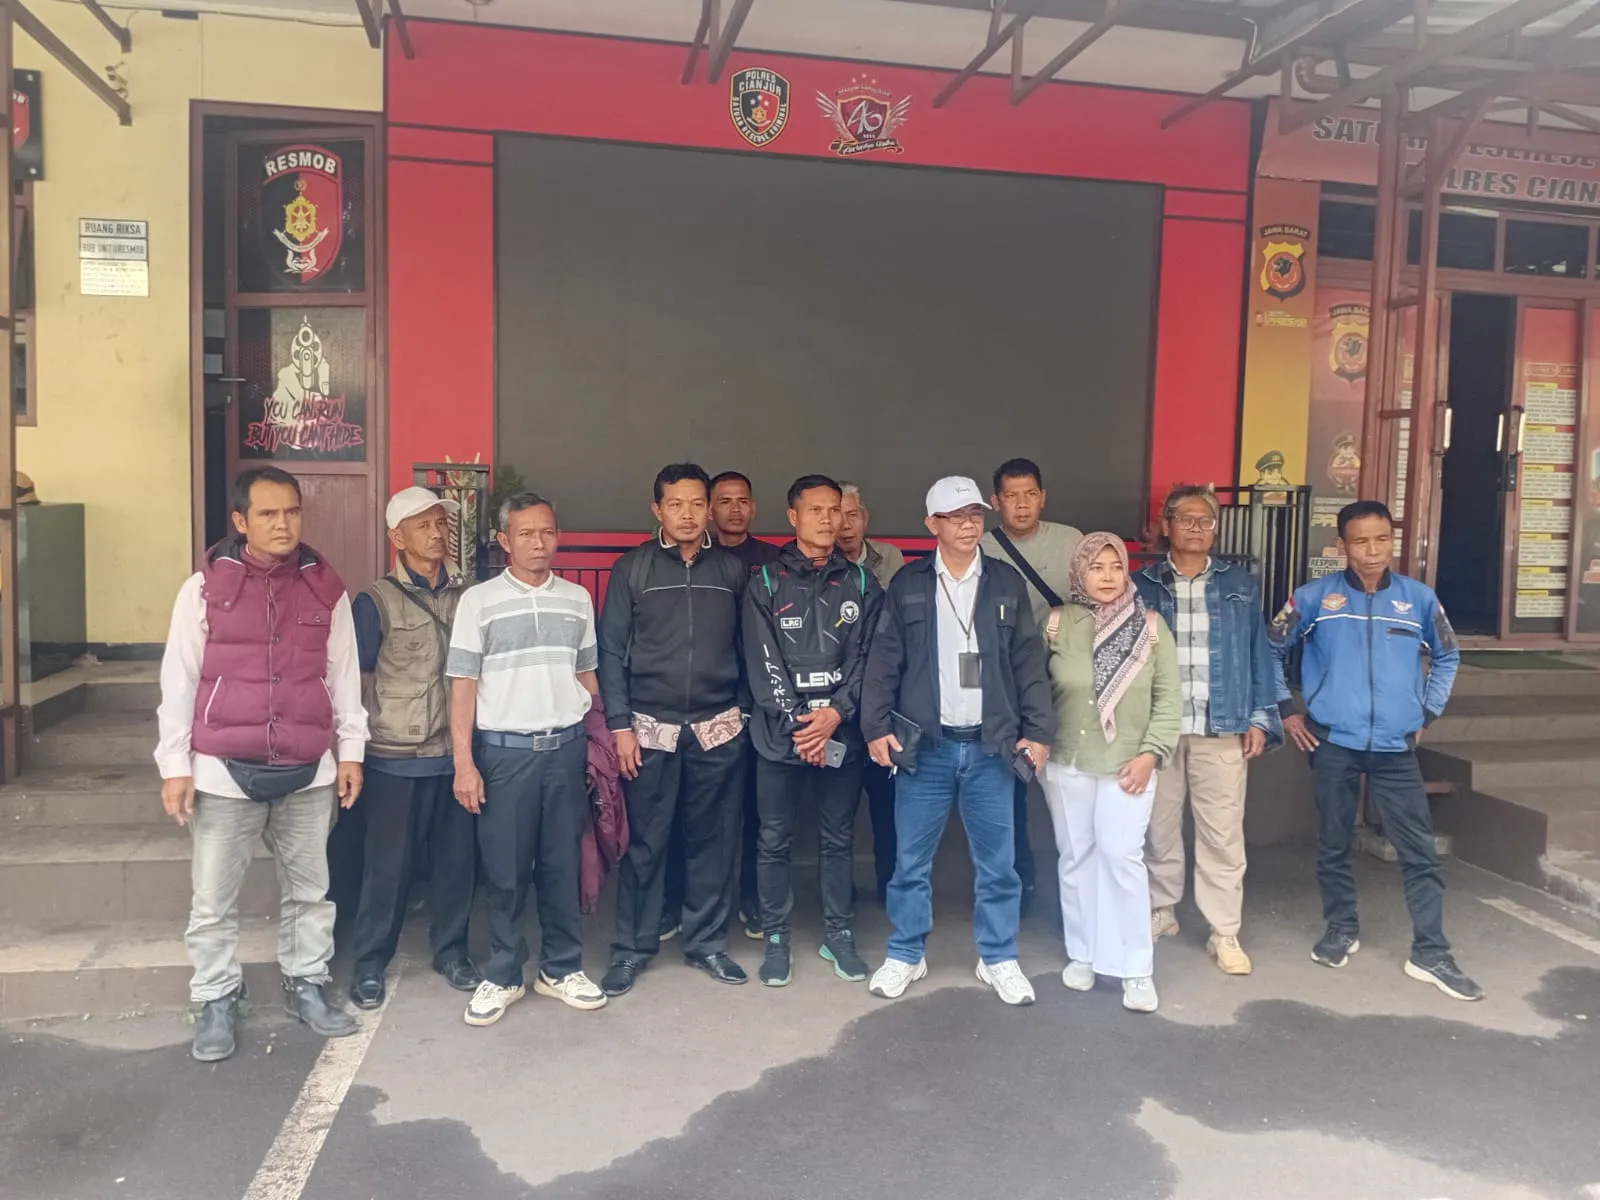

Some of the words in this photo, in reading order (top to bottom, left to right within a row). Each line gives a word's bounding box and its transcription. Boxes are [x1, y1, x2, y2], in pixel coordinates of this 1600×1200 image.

[739, 80, 781, 96] CIANJUR
[745, 71, 776, 83] POLRES
[265, 151, 336, 177] RESMOB
[1526, 175, 1600, 204] CIAN
[85, 222, 114, 234] RUANG
[116, 224, 141, 234] RIKSA
[264, 398, 290, 422] YOU
[291, 397, 317, 421] CAN
[316, 396, 346, 421] RUN
[246, 422, 271, 449] BUT
